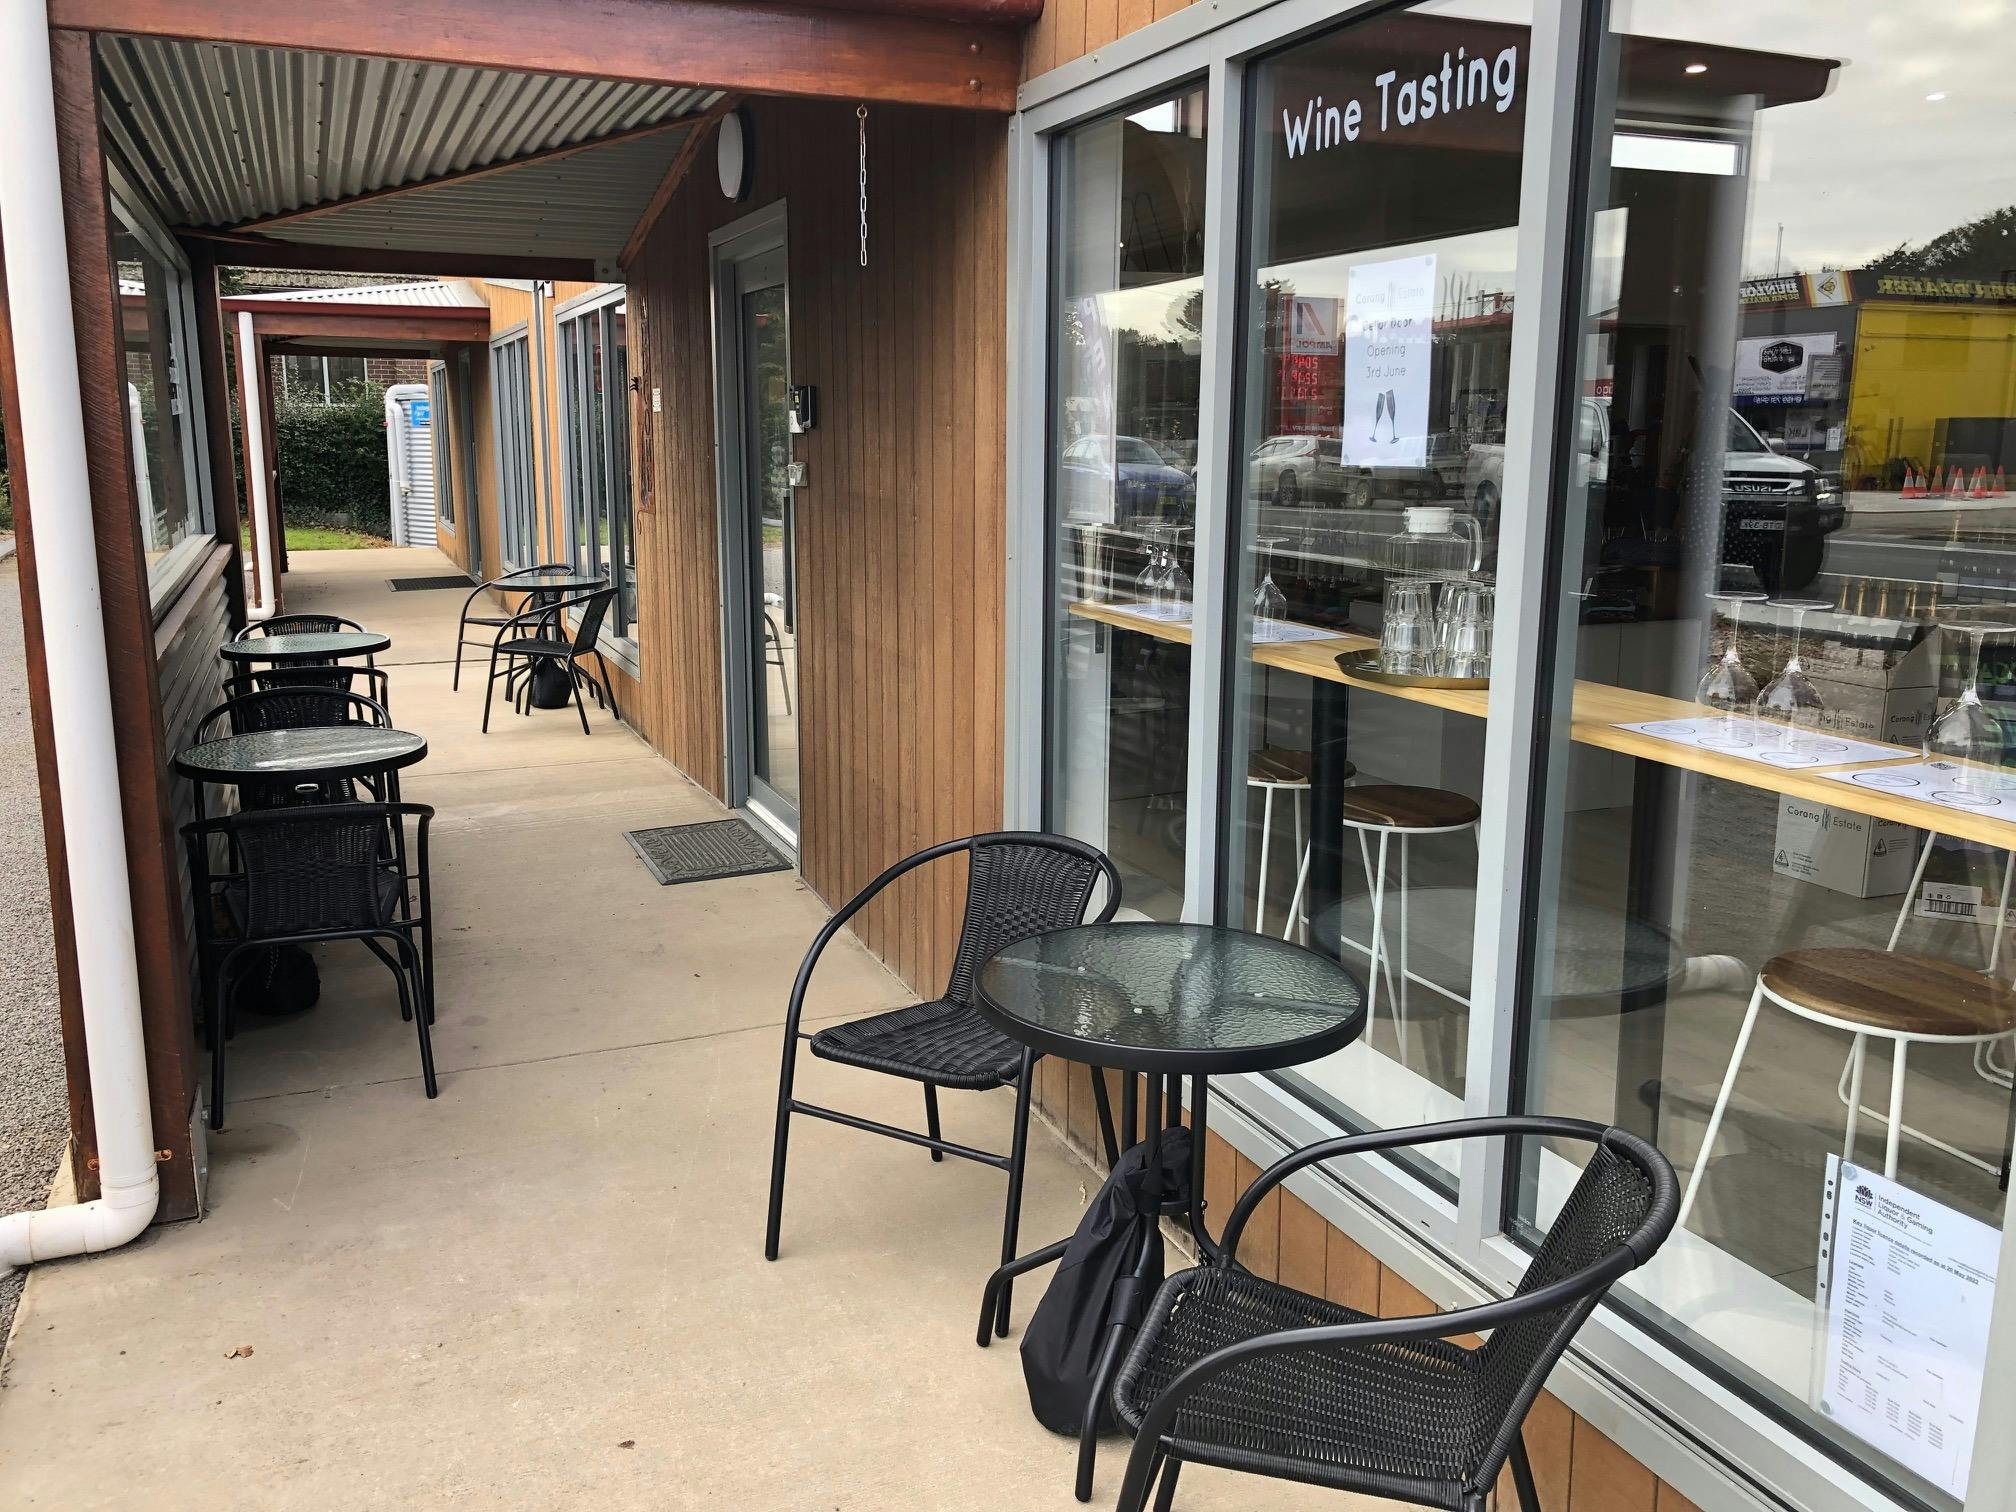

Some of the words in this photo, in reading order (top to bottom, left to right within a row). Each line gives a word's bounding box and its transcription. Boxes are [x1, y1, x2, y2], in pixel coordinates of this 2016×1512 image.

[1283, 96, 1362, 159] Wine
[1375, 45, 1517, 132] Tasting
[1391, 318, 1413, 329] Door
[1366, 344, 1407, 359] Opening
[1365, 366, 1381, 379] 3rd
[1384, 365, 1407, 378] June
[1845, 717, 1875, 731] Estate
[1787, 805, 1820, 823] Corang
[1833, 816, 1862, 832] Estate
[1855, 1194, 1873, 1207] NSW
[1878, 1194, 1921, 1220] Independent
[1877, 1209, 1908, 1230] Authority
[1878, 1202, 1899, 1217] Liquor
[1906, 1216, 1934, 1235] Gaming
